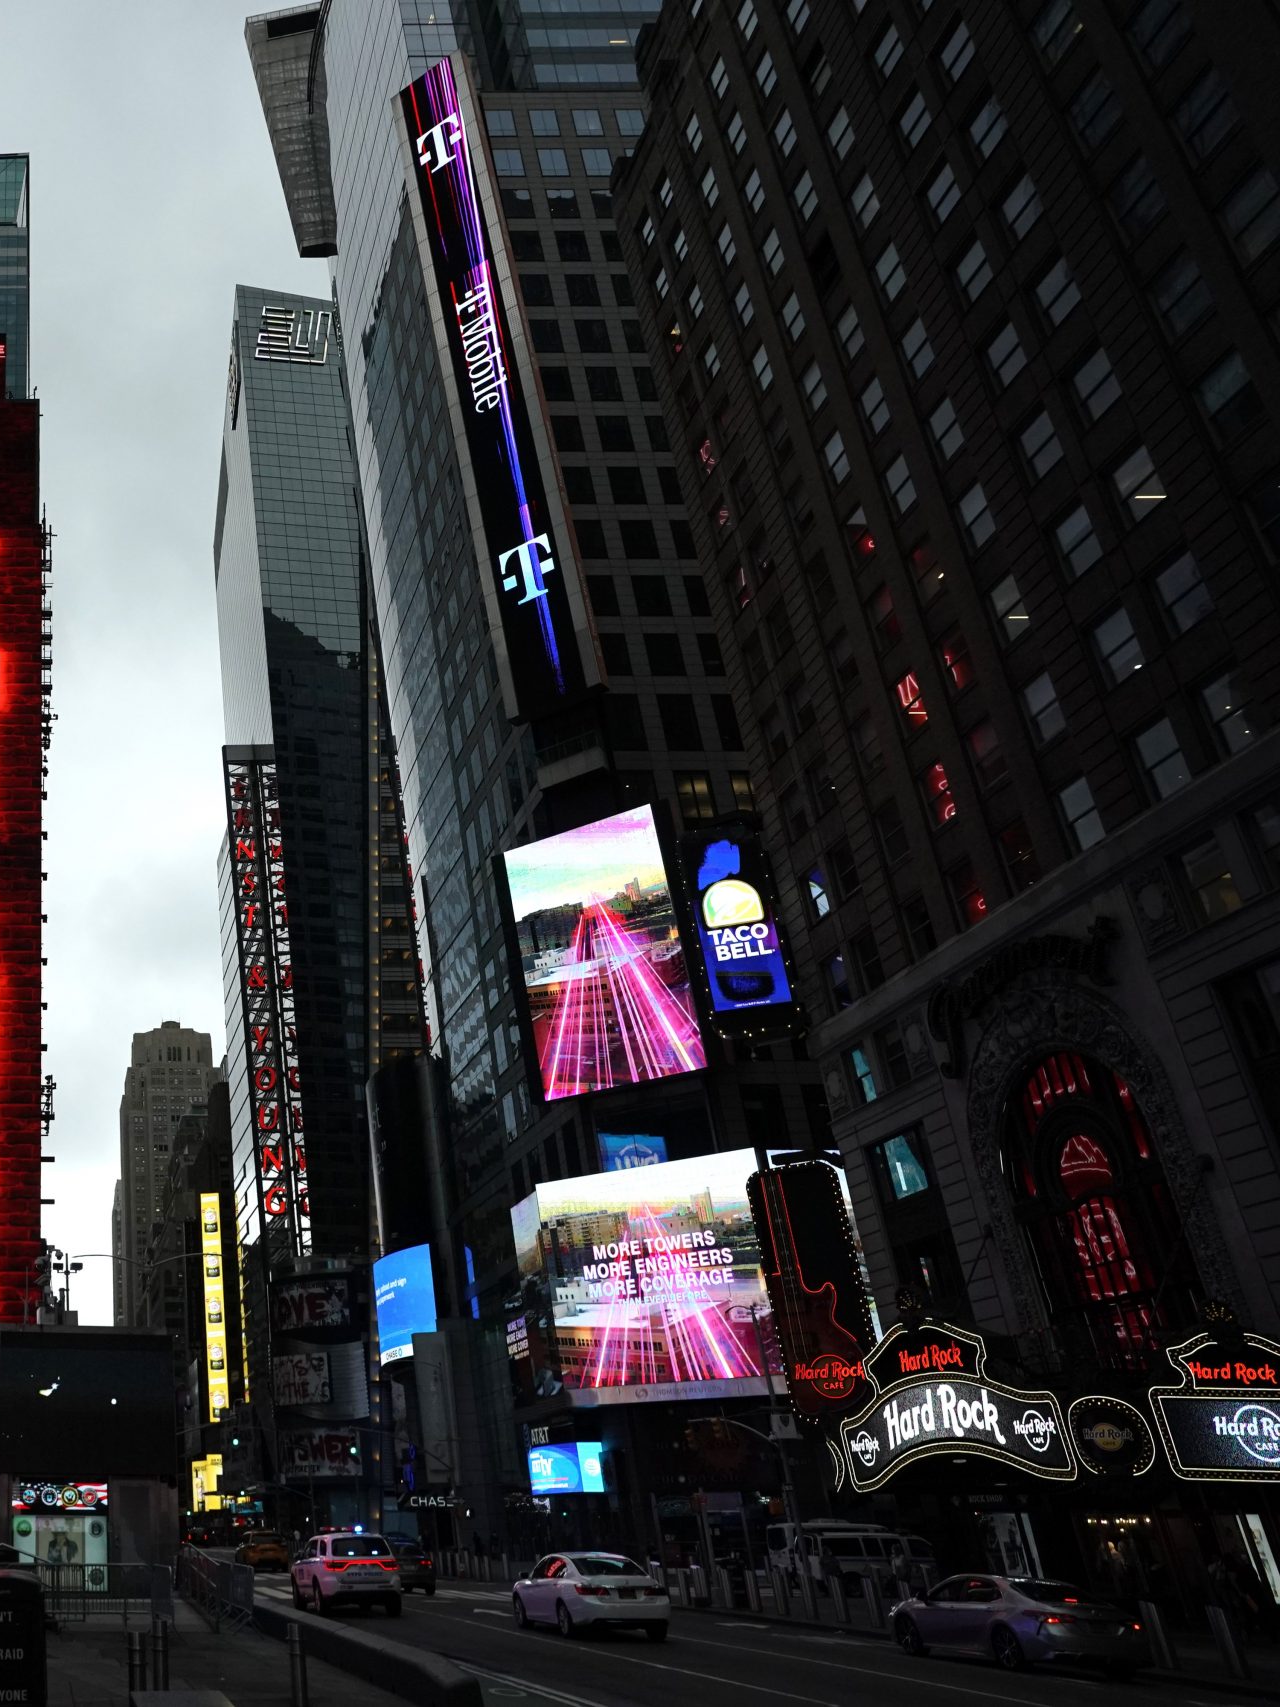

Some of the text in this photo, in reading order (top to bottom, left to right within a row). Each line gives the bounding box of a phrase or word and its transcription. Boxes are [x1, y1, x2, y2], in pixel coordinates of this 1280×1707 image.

[456, 281, 508, 413] T-Mobile
[707, 922, 769, 946] TACO
[715, 940, 773, 961] BELL
[232, 777, 287, 1216] ERNST & YOUNG
[592, 1230, 716, 1261] MORE TOWERS
[583, 1248, 734, 1281] MORE ENGINEERS
[588, 1267, 735, 1298] MORE COVERAGE
[617, 1290, 708, 1306] THAN EVER BEFORE
[899, 1340, 964, 1374] Hard Rock
[795, 1361, 866, 1381] Hard Rock
[1188, 1361, 1278, 1385] Hard Rock
[824, 1381, 845, 1390] CAFE
[883, 1383, 1007, 1450] Hard Rock
[1013, 1416, 1057, 1436] Hard Rock
[1213, 1415, 1259, 1436] Hard
[531, 1426, 550, 1444] AT&T
[1083, 1428, 1134, 1442] Hard Rock
[410, 1495, 455, 1508] CHAS
